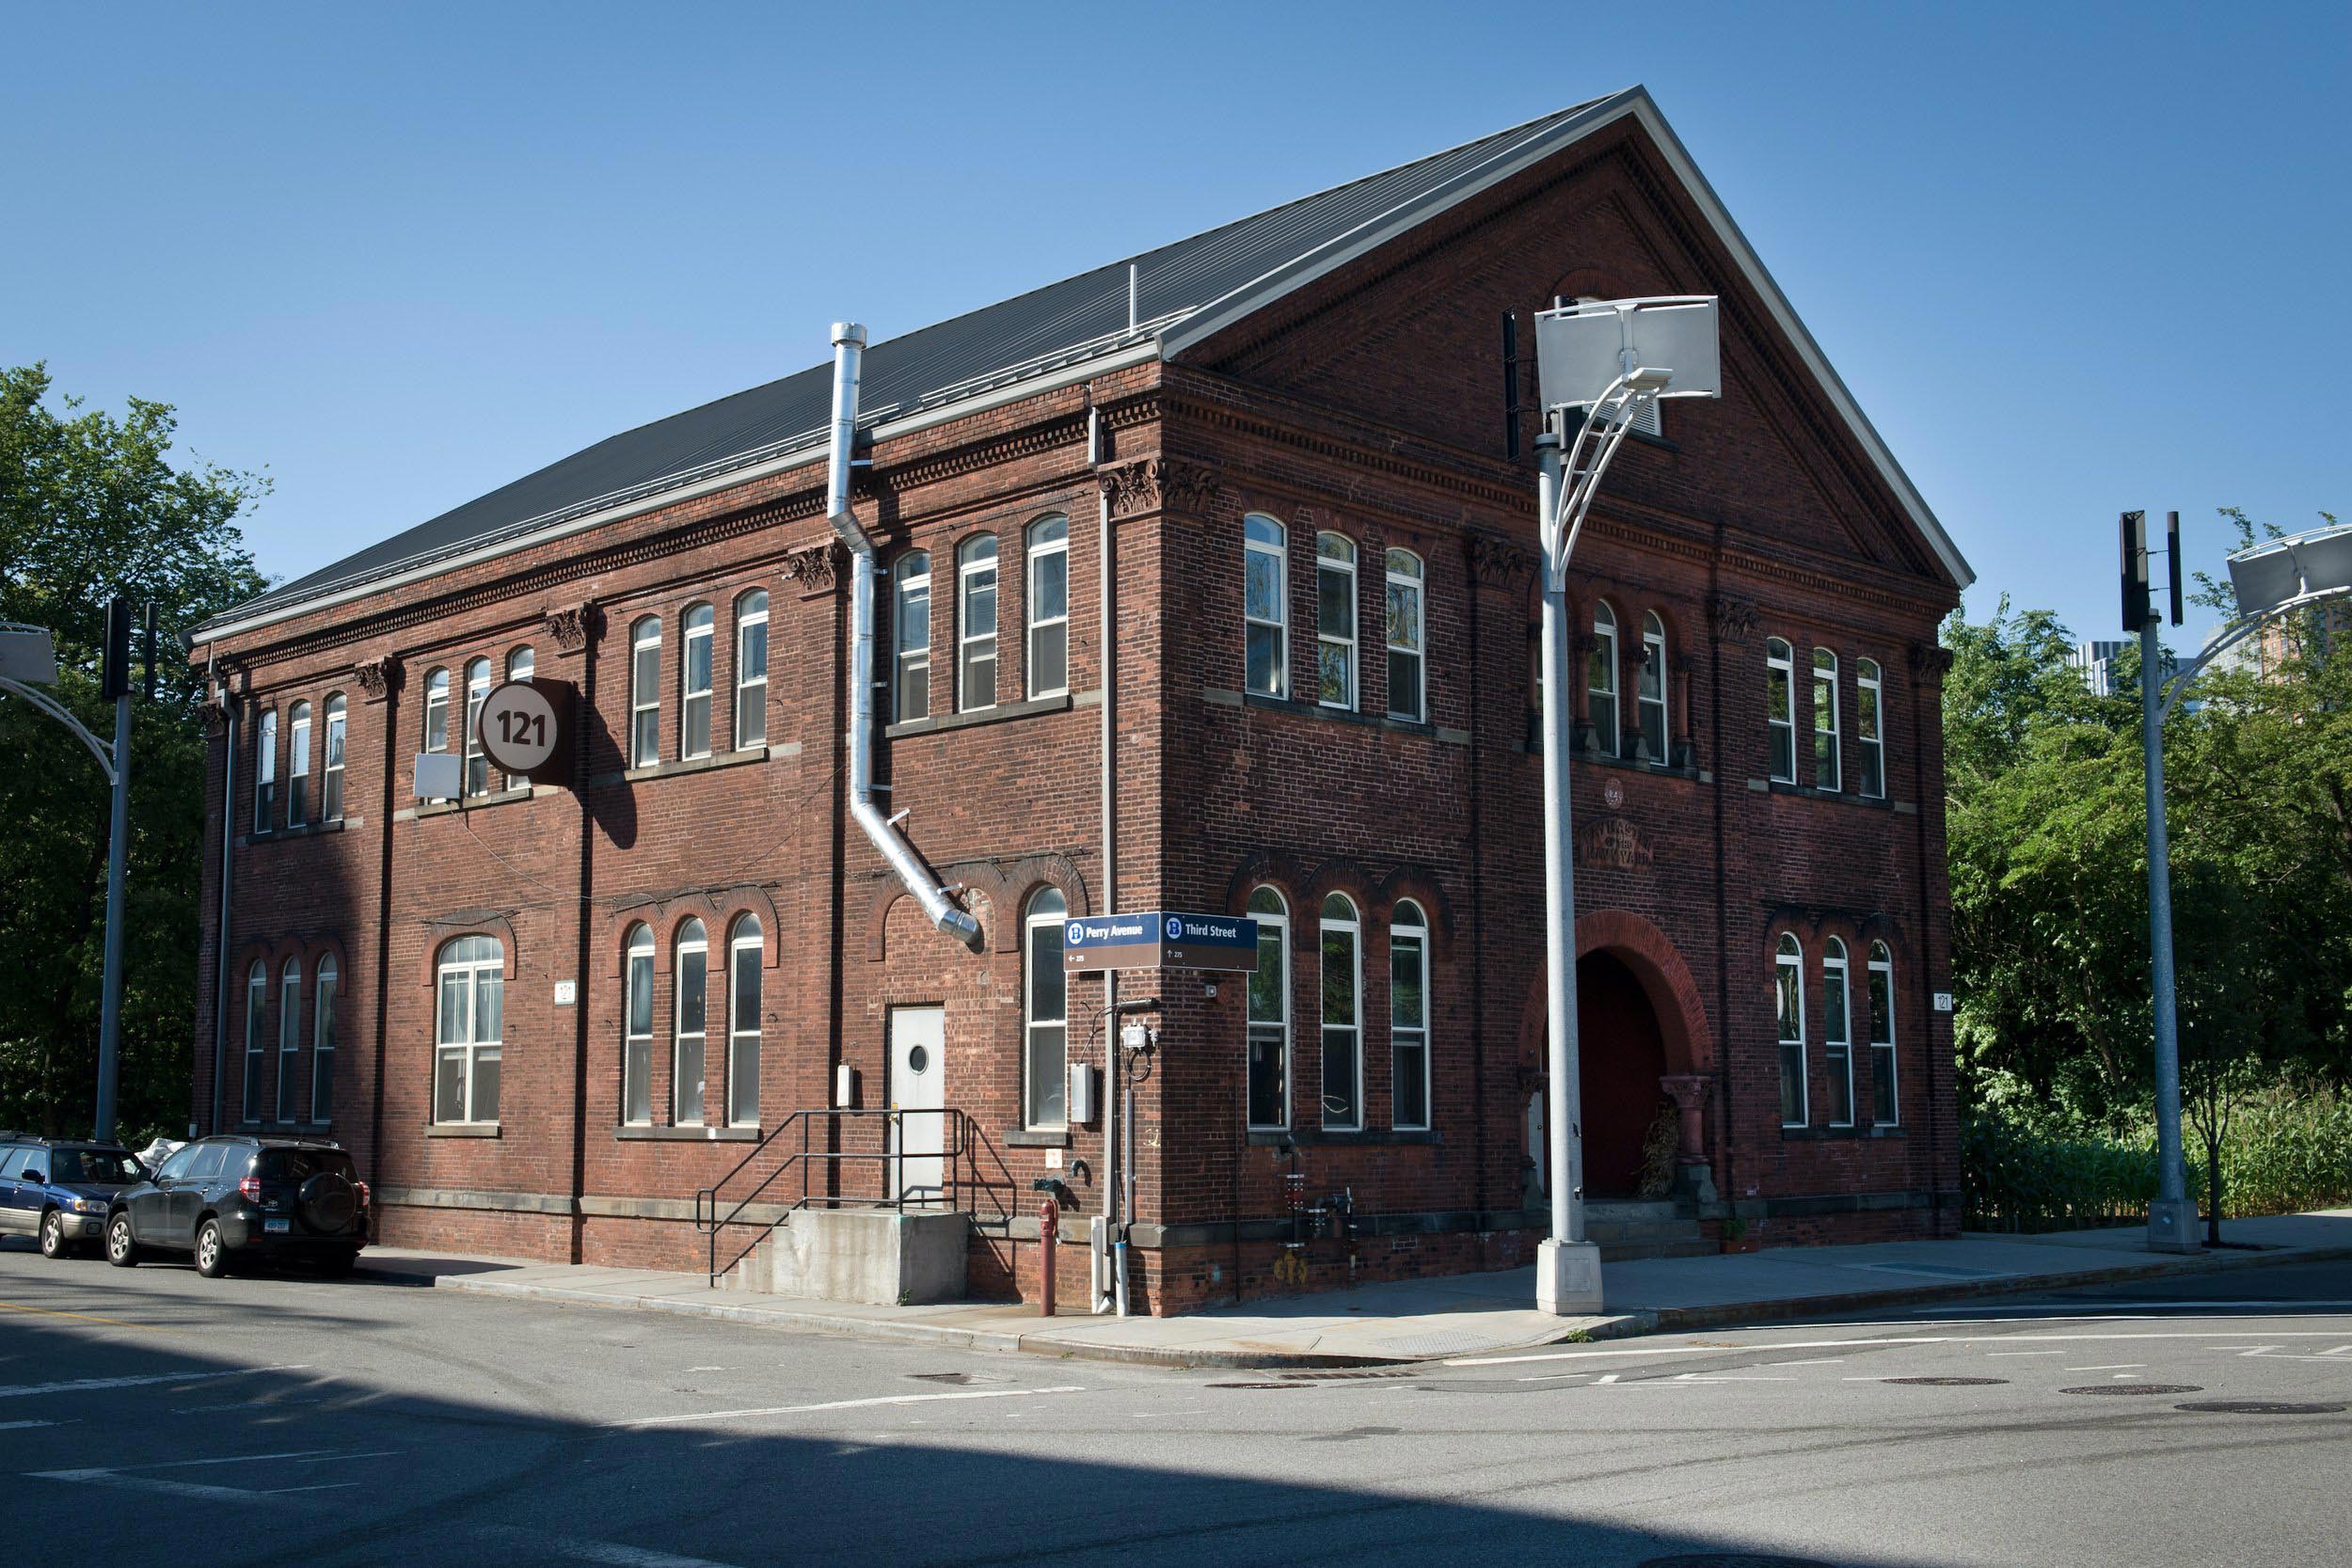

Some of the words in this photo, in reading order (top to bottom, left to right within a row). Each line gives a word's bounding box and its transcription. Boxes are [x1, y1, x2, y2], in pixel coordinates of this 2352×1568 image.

[497, 710, 546, 747] 121
[1086, 927, 1110, 941] Perry
[1111, 925, 1143, 937] Avenue
[1185, 924, 1209, 936] Third
[1210, 926, 1237, 938] Street
[1938, 994, 1948, 1009] 121
